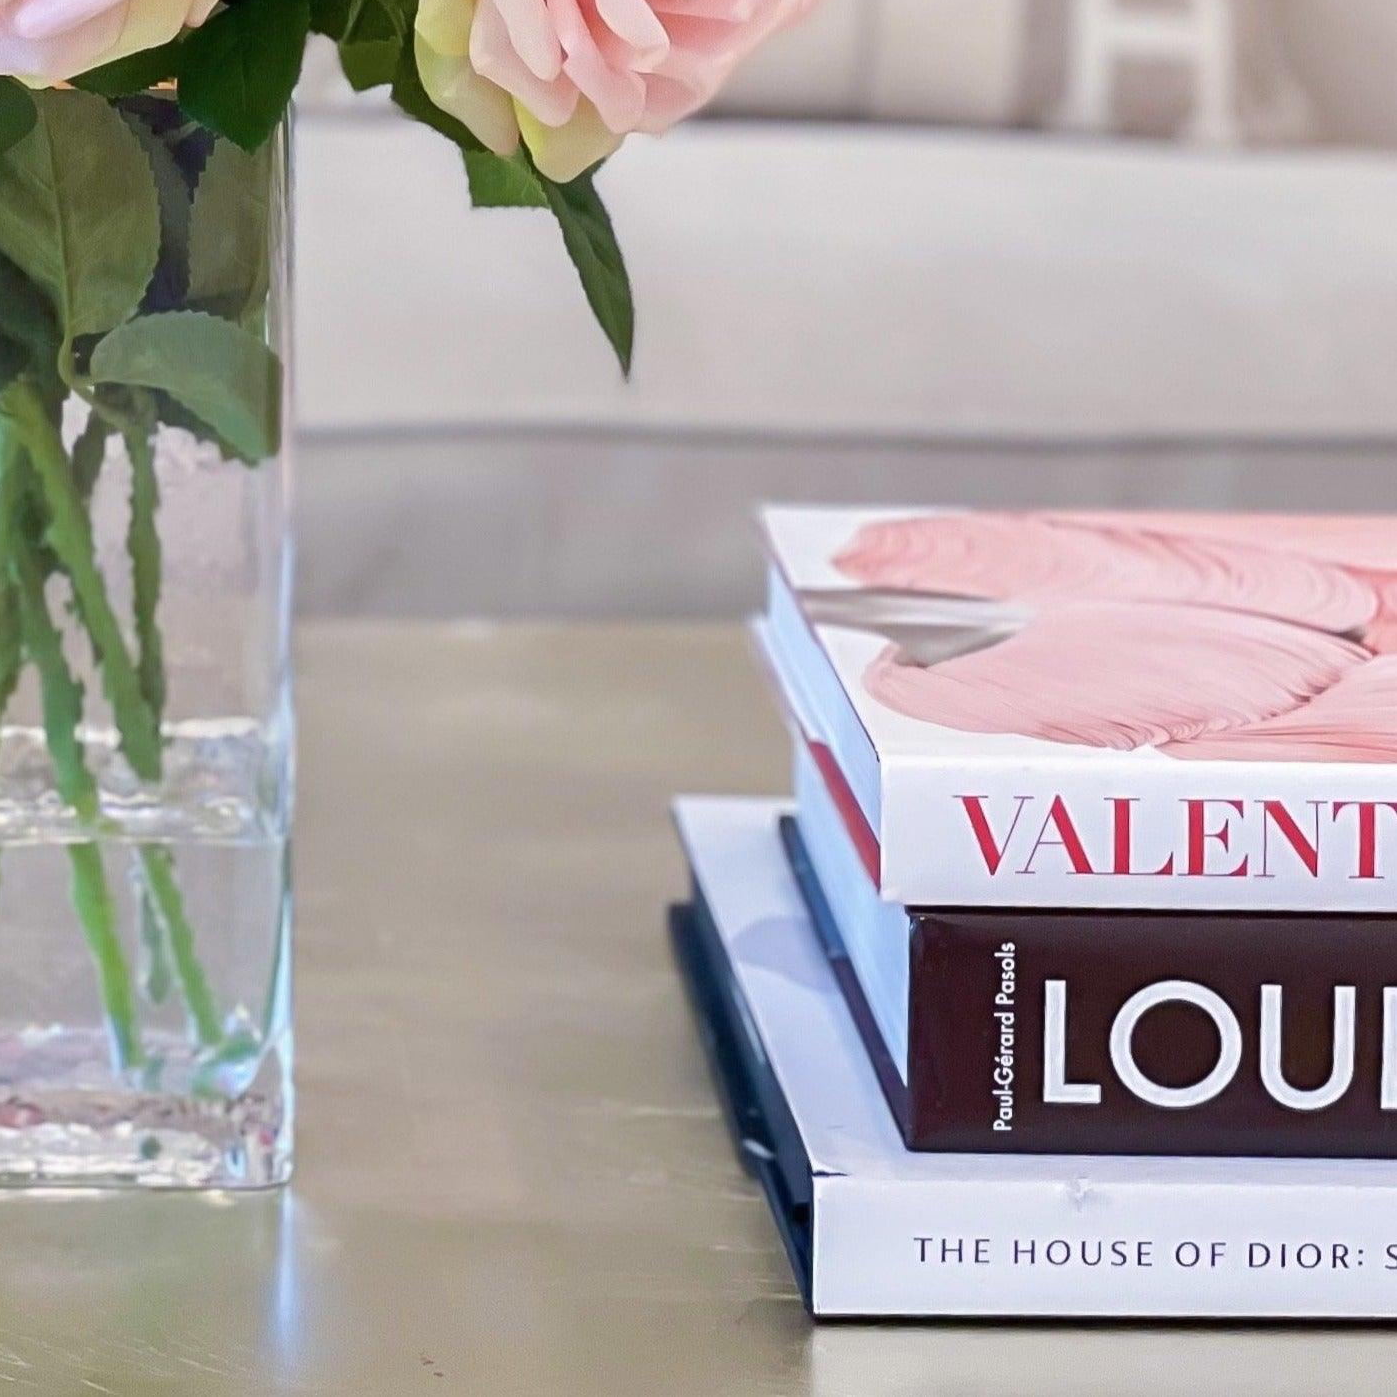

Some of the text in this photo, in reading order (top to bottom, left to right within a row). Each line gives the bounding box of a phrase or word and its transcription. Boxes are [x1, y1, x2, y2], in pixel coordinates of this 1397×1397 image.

[952, 793, 1397, 881] VALENT
[992, 941, 1016, 1132] Paul-Gérard Pasols
[913, 1237, 991, 1264] THE
[1014, 1239, 1153, 1267] HOUSE
[1175, 1241, 1227, 1267] OF
[1248, 1242, 1365, 1270] DIOR:
